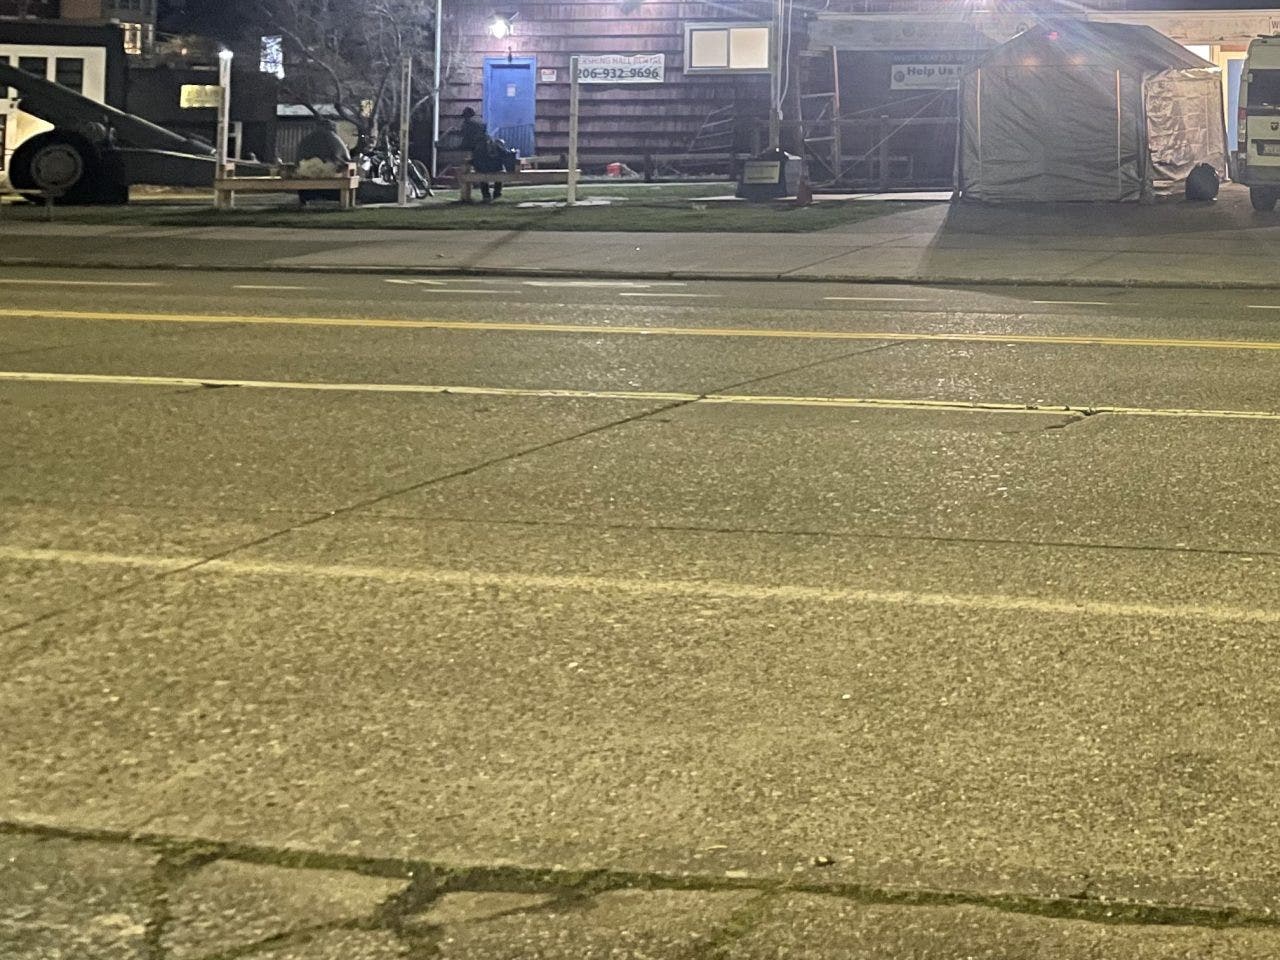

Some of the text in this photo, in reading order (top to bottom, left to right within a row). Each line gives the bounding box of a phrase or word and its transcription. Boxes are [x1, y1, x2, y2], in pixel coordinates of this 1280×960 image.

[577, 67, 659, 79] 206-932-9696
[907, 66, 935, 77] Help
[938, 66, 954, 76] Us
